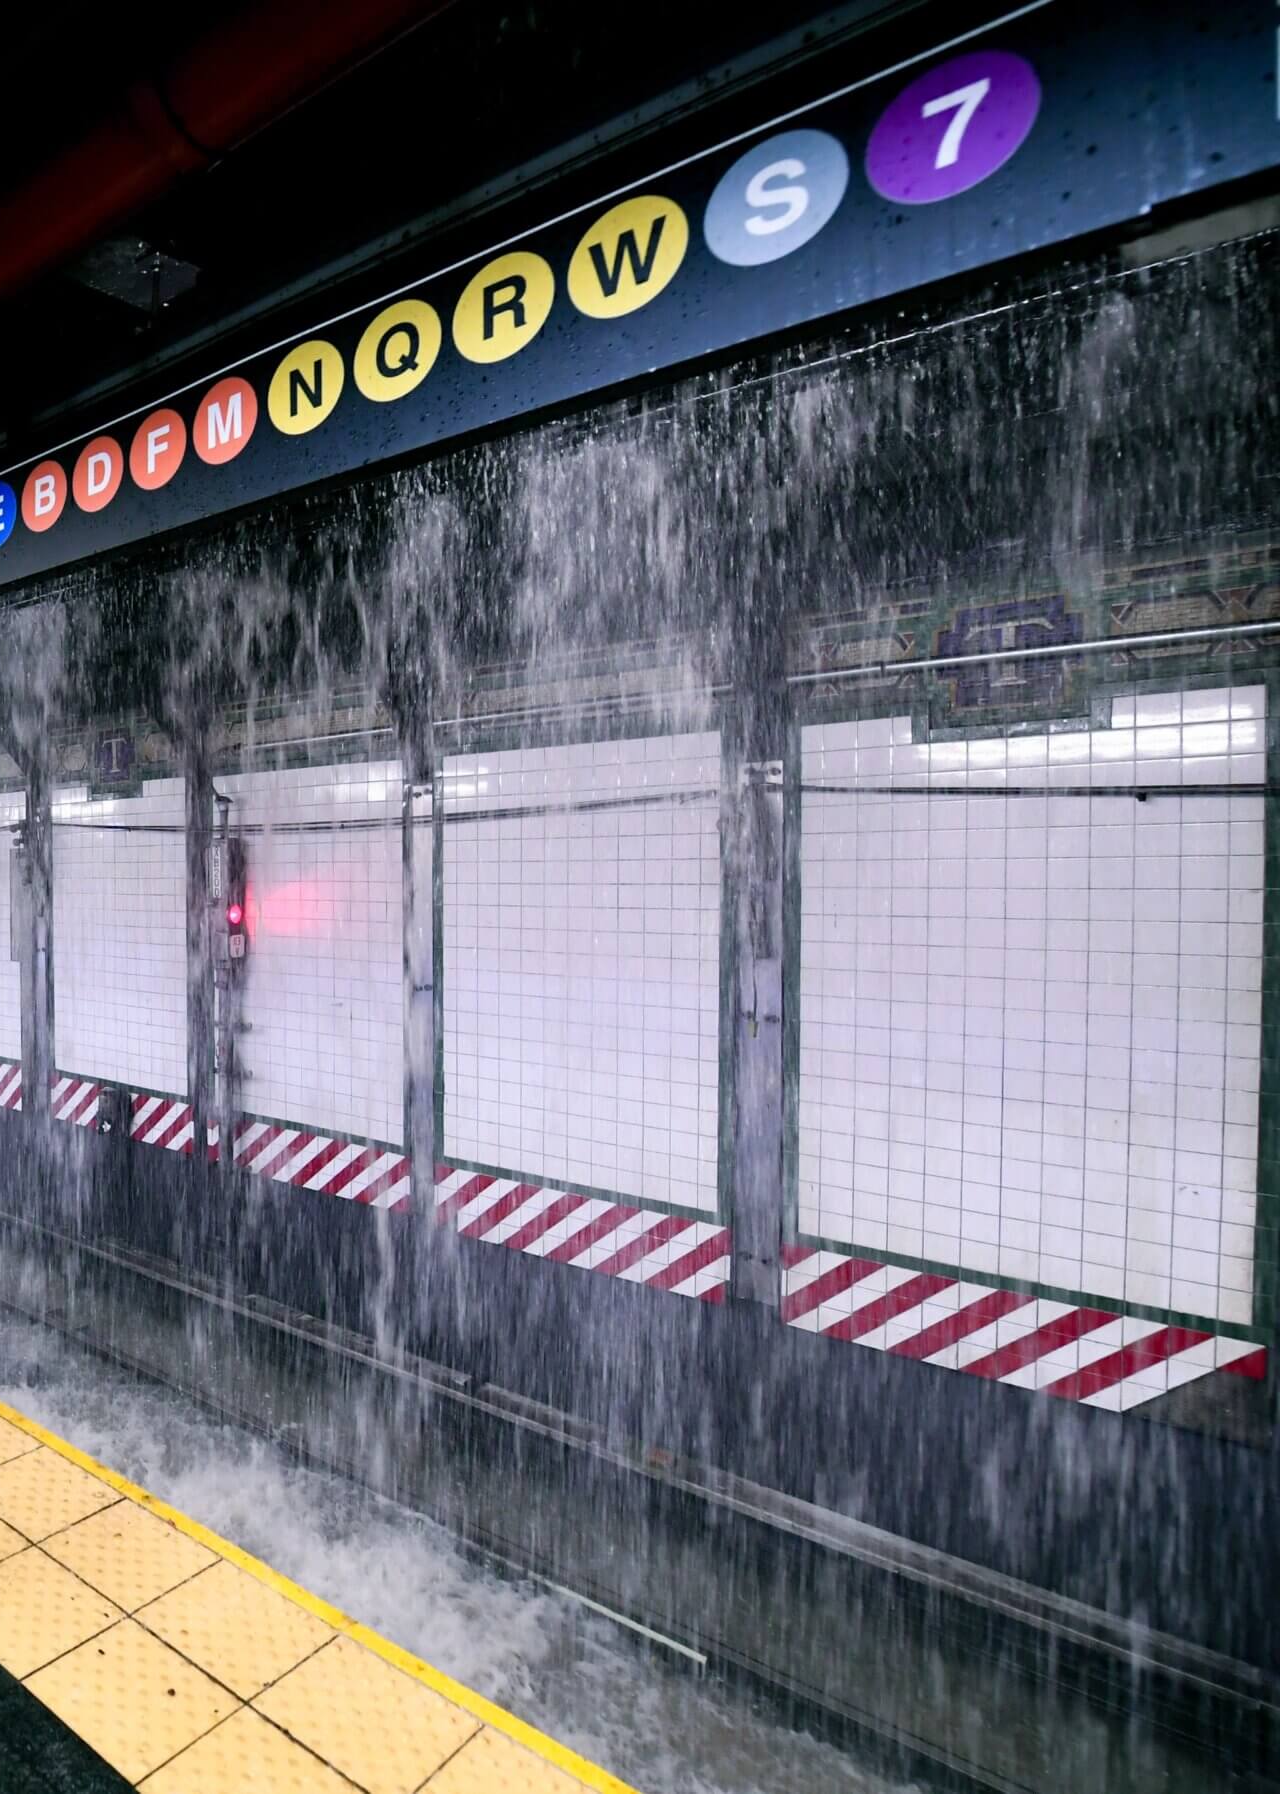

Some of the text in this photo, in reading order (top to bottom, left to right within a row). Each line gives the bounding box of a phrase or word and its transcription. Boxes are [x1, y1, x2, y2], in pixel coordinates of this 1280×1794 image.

[33, 474, 56, 517] B
[86, 450, 112, 497] D
[146, 423, 171, 474] F
[206, 391, 243, 450] M
[289, 358, 323, 418] N
[375, 320, 420, 379] Q
[482, 273, 527, 341] R
[587, 214, 668, 299] W
[743, 157, 810, 236] S
[921, 77, 991, 170] 7
